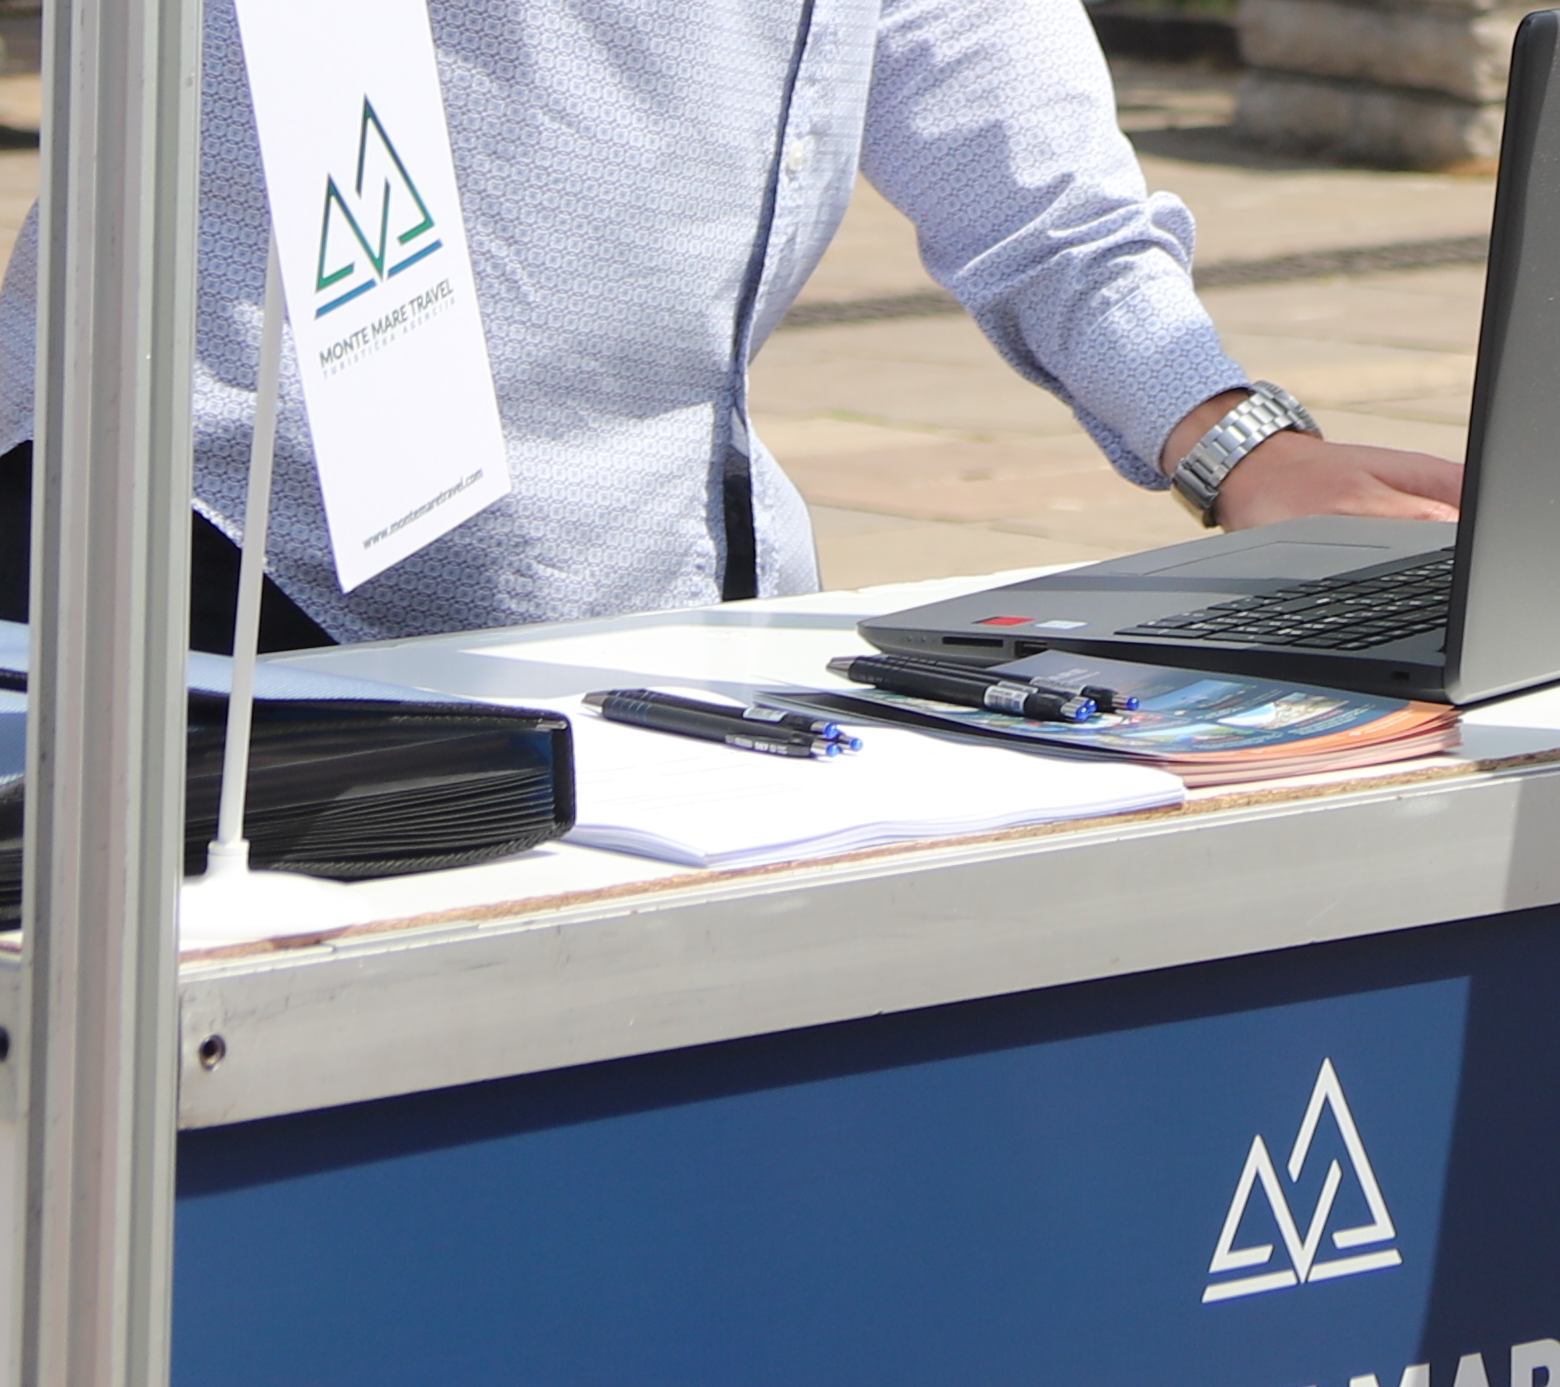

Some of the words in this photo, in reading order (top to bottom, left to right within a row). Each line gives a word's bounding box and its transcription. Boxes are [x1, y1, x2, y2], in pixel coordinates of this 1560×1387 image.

[318, 325, 370, 369] MONTE
[371, 304, 409, 340] MARE
[409, 277, 455, 317] TRAVEL
